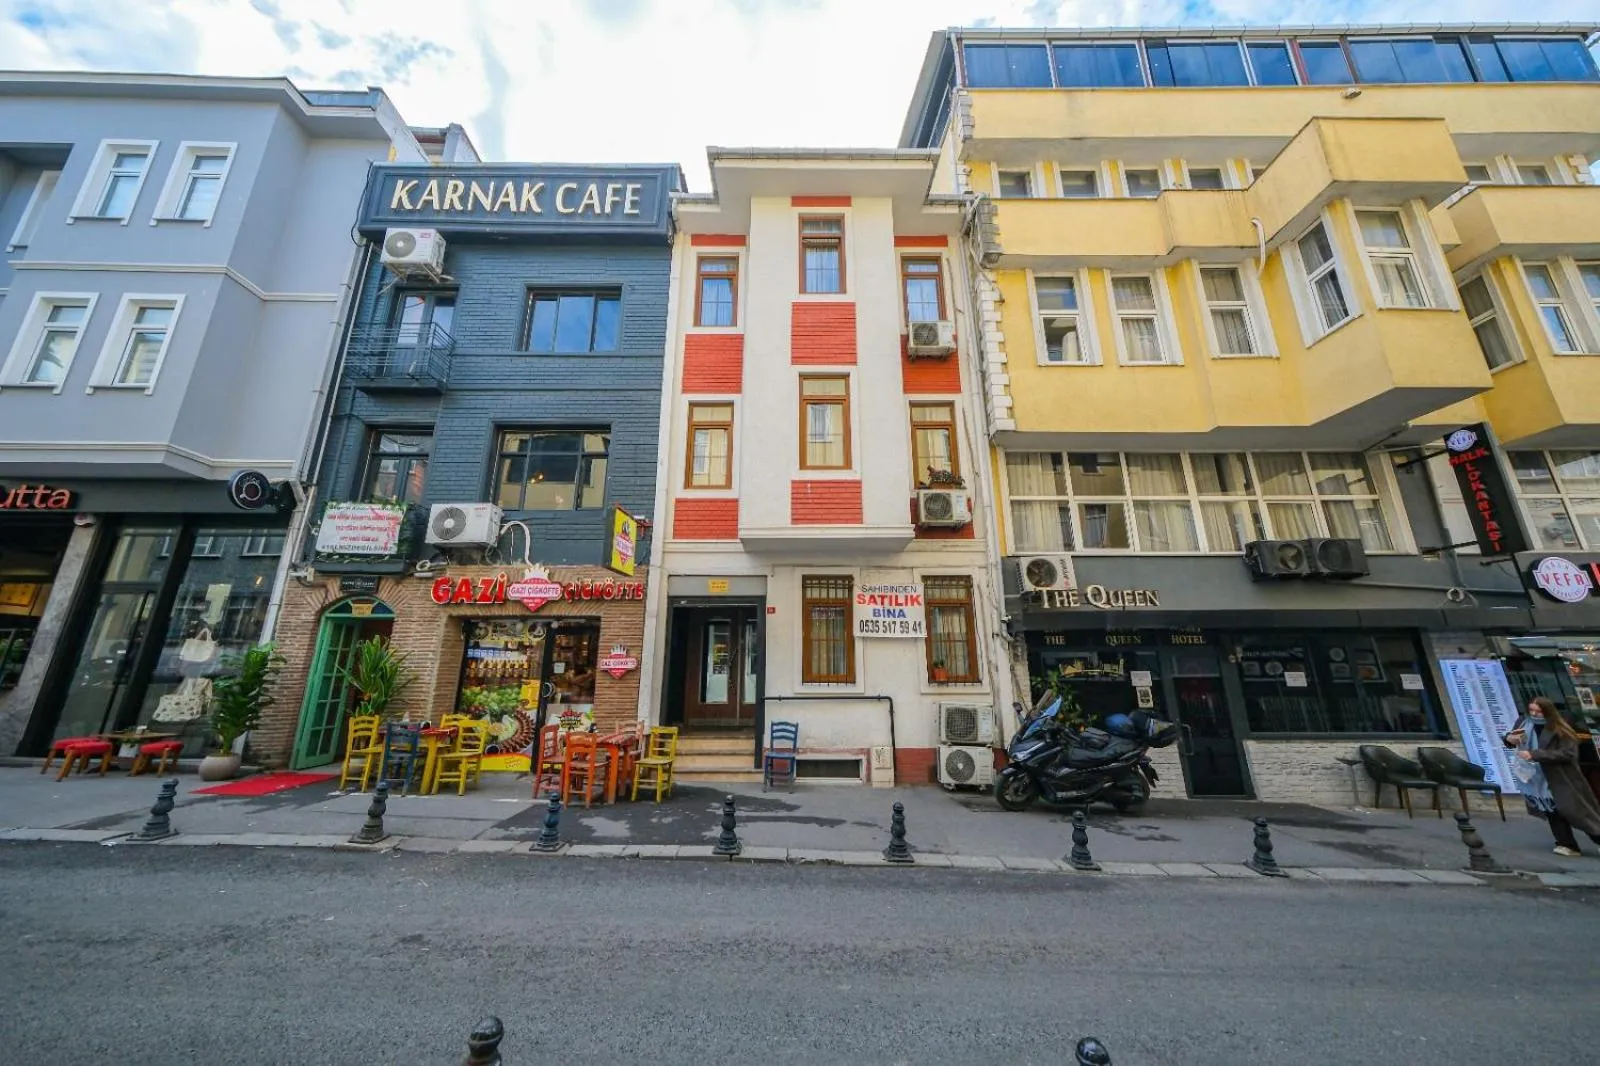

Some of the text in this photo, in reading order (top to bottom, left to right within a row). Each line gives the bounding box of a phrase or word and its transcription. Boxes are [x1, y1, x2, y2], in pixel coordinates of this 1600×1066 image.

[390, 179, 642, 215] KARNAK CAFE
[1540, 572, 1584, 586] VEFA
[431, 572, 509, 605] GAZİ
[856, 593, 922, 606] SATILIK
[1035, 584, 1160, 609] THE QUEEN
[859, 620, 923, 634] 0535 517 59 41
[1044, 634, 1206, 646] THE QUEEN HOTEL
